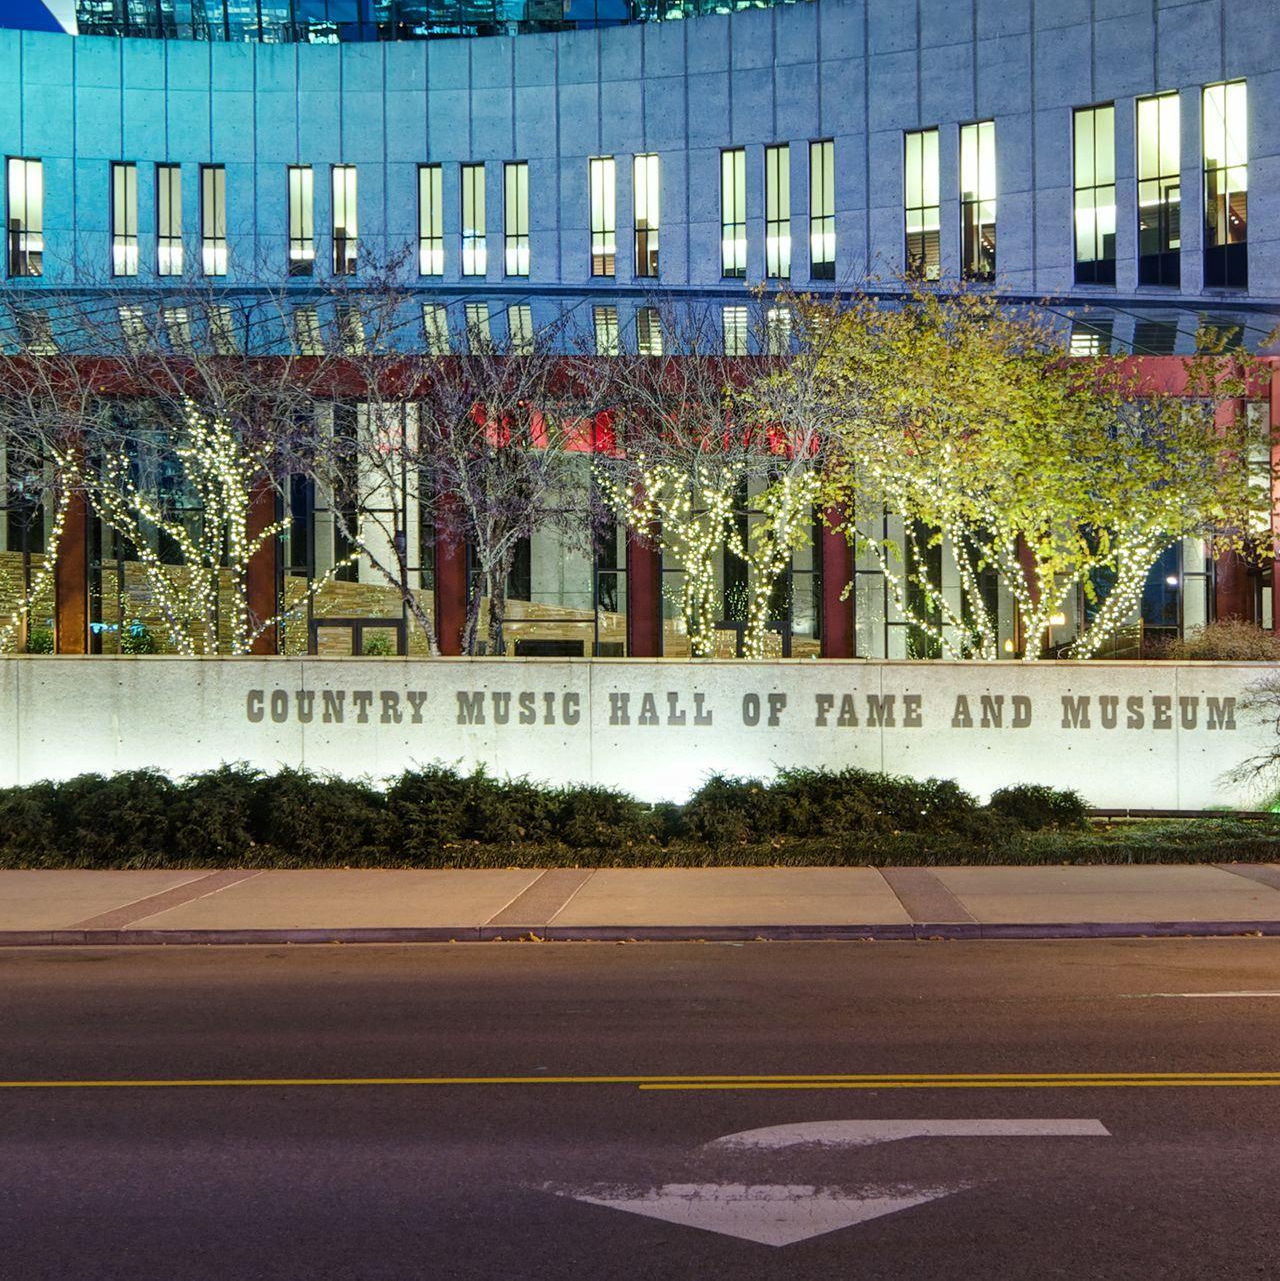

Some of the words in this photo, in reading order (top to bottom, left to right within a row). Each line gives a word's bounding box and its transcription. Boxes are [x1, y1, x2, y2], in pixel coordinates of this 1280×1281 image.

[246, 689, 428, 724] COUNTRY
[456, 691, 581, 726] MUSIC
[608, 692, 714, 726] HALL
[742, 693, 787, 727] OF
[815, 694, 924, 728] FAME
[951, 694, 1032, 729] AND
[1061, 696, 1237, 731] MUSEUM
